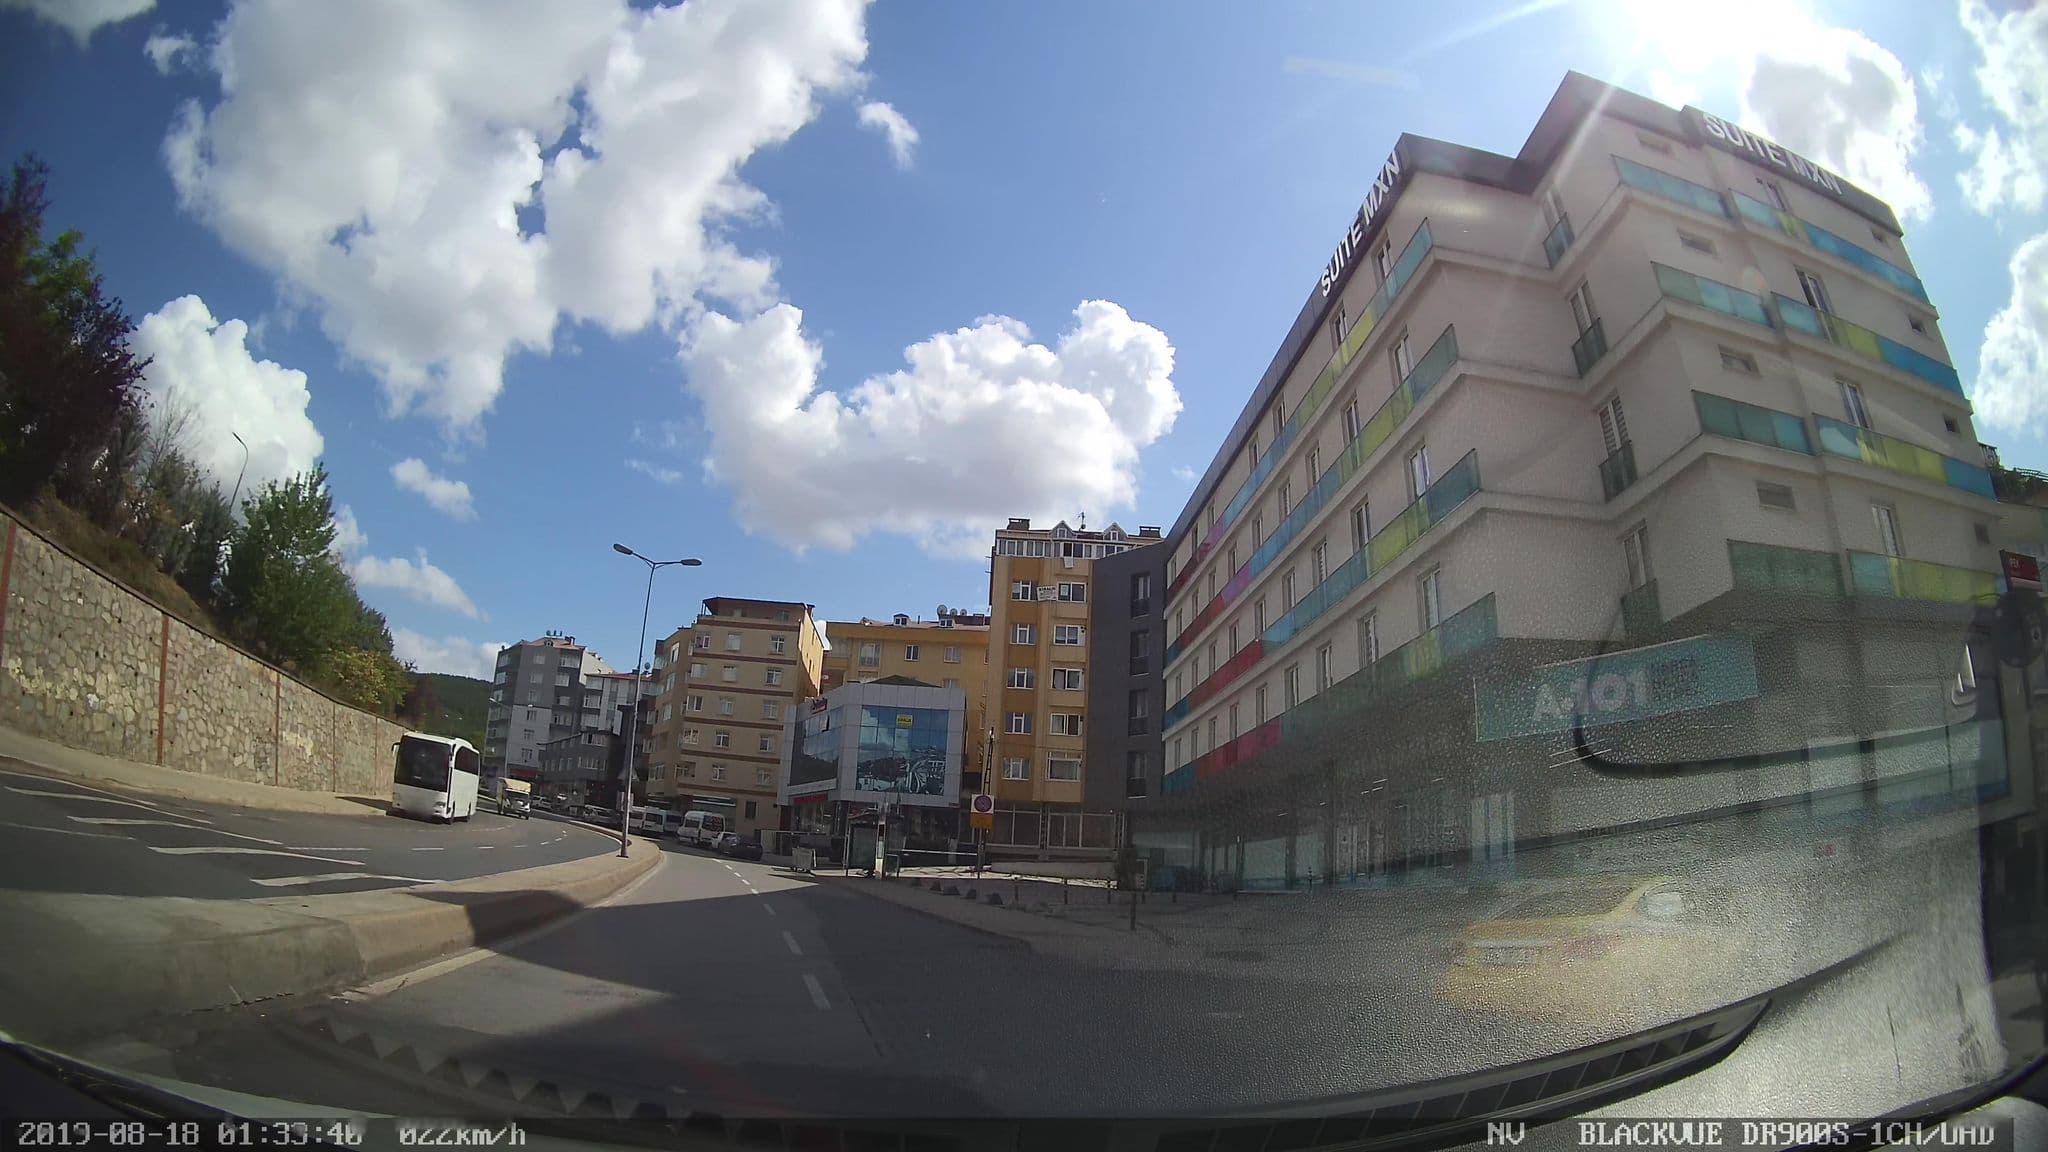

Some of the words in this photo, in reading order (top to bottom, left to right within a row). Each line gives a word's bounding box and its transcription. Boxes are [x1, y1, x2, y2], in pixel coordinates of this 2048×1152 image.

[1703, 112, 1787, 167] SUITE
[1785, 151, 1842, 195] MXN
[1321, 214, 1363, 297] SUITE
[1362, 150, 1401, 226] MXN
